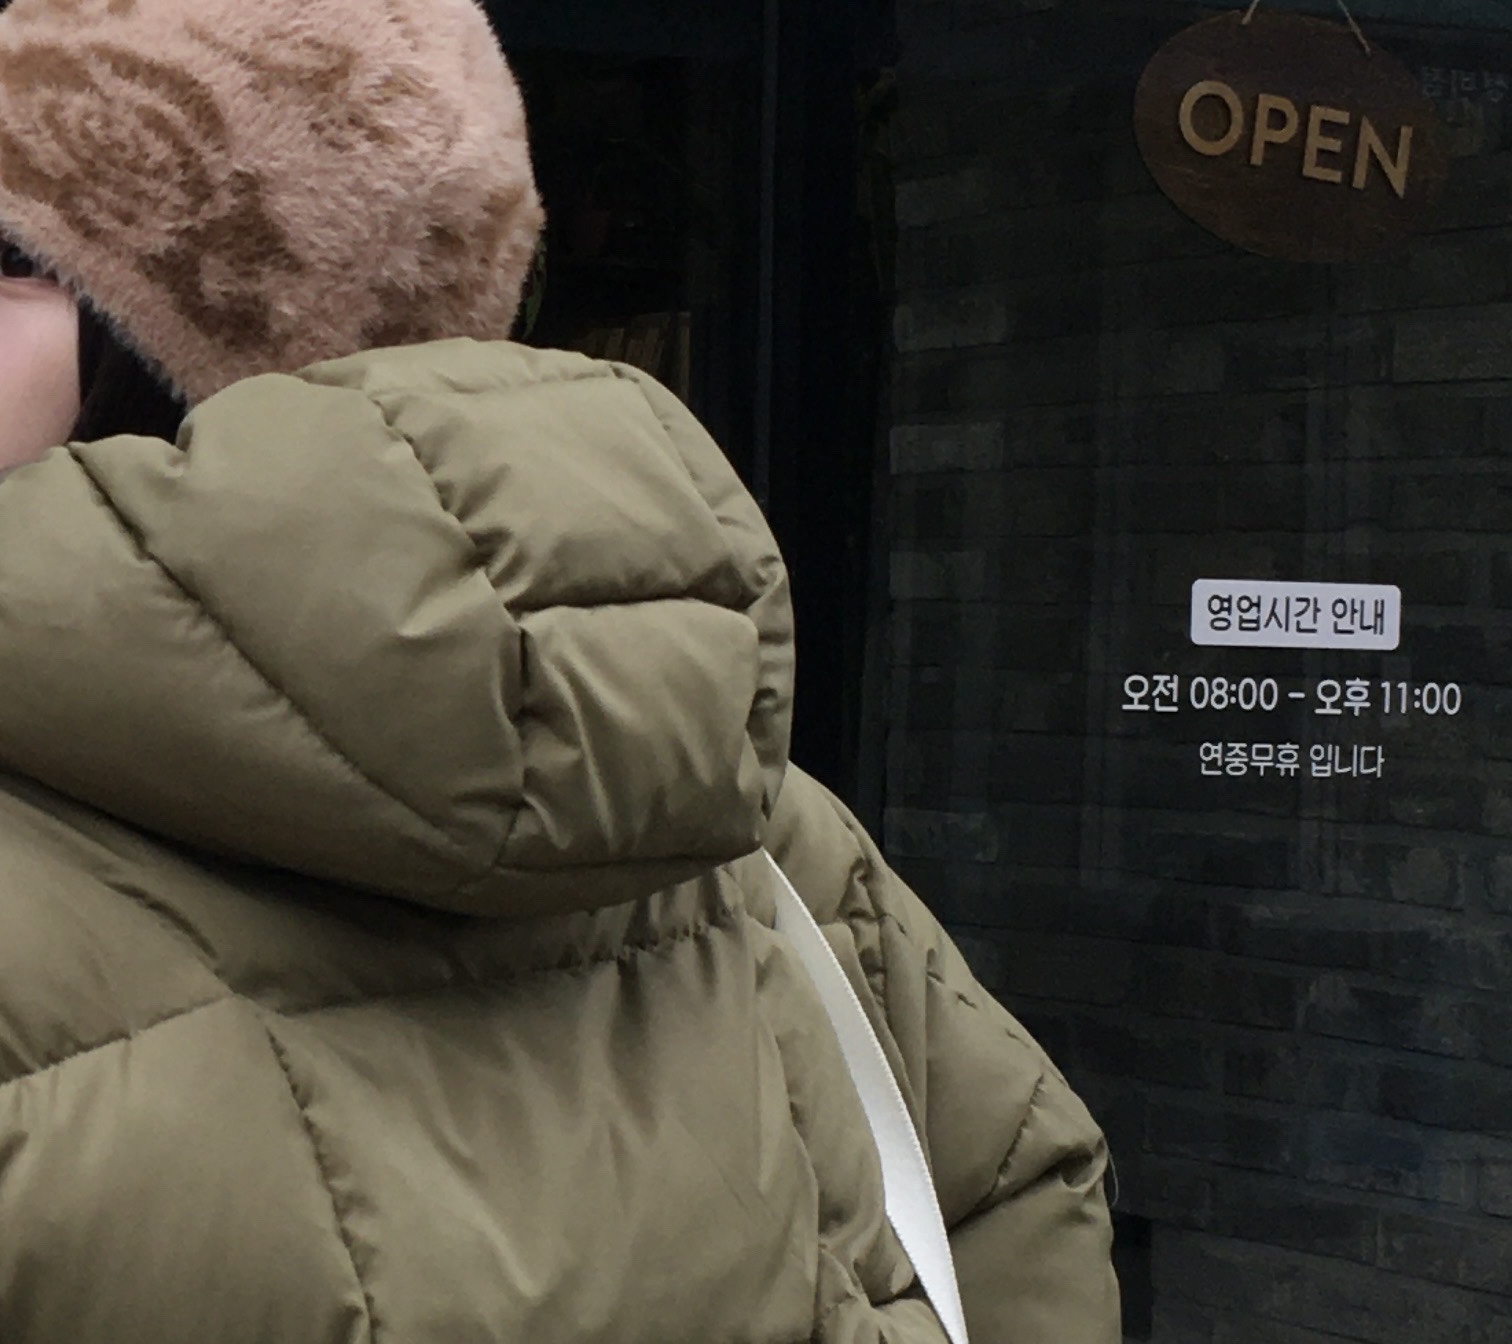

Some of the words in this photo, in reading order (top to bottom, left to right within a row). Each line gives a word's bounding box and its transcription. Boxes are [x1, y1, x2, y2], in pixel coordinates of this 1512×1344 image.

[1179, 80, 1412, 198] OPEN
[1207, 594, 1321, 633] 영업시간
[1332, 598, 1384, 635] 안내
[1122, 674, 1178, 712] 오전
[1190, 676, 1278, 711] 08:00
[1315, 678, 1371, 717] 오후
[1381, 681, 1462, 715] 11:00
[1199, 742, 1299, 777] 연중무휴
[1310, 744, 1384, 778] 입니다
